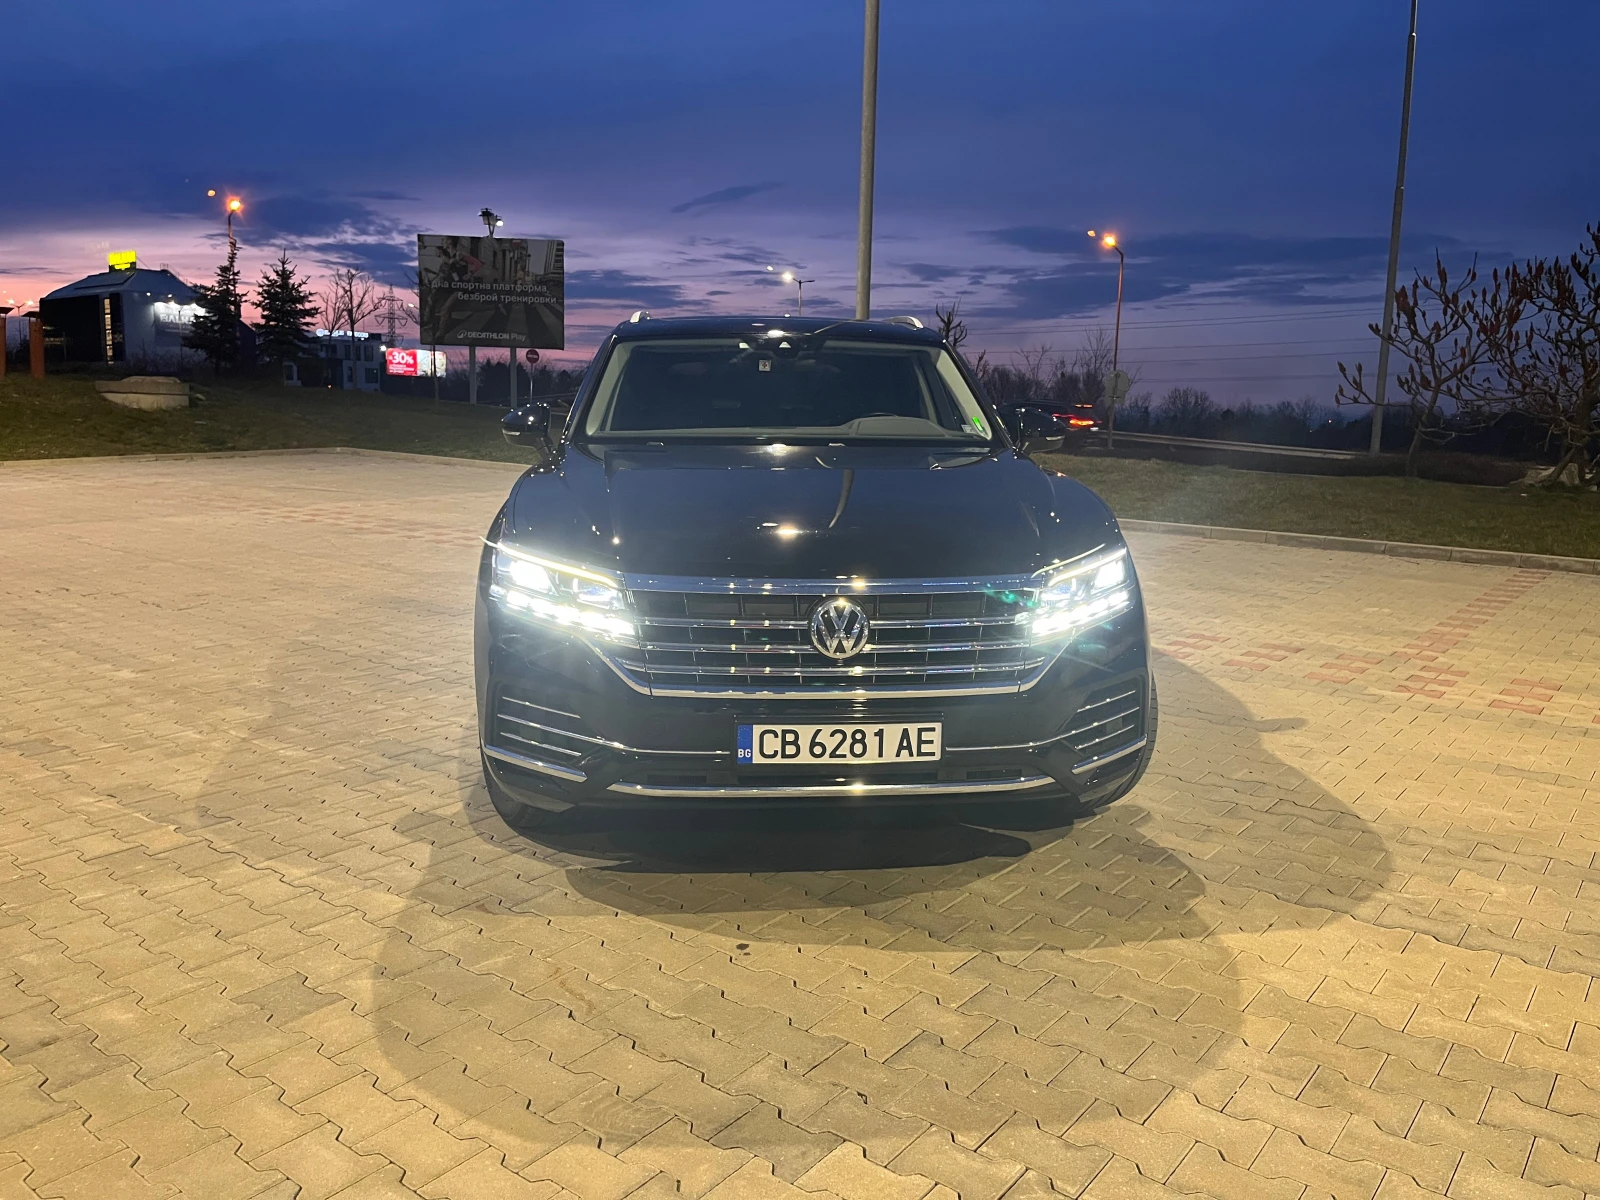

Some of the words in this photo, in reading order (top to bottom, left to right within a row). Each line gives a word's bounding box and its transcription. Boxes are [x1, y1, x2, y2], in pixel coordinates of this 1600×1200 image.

[428, 280, 449, 289] дна
[451, 281, 491, 291] спортна
[493, 282, 550, 294] платформа,
[457, 291, 498, 302] безброй
[500, 294, 557, 305] тренировки
[467, 331, 510, 341] DECATHLON
[511, 332, 527, 342] Play
[738, 749, 752, 758] BG
[758, 728, 801, 759] CB
[808, 728, 885, 759] 6281
[895, 727, 937, 758] AE
